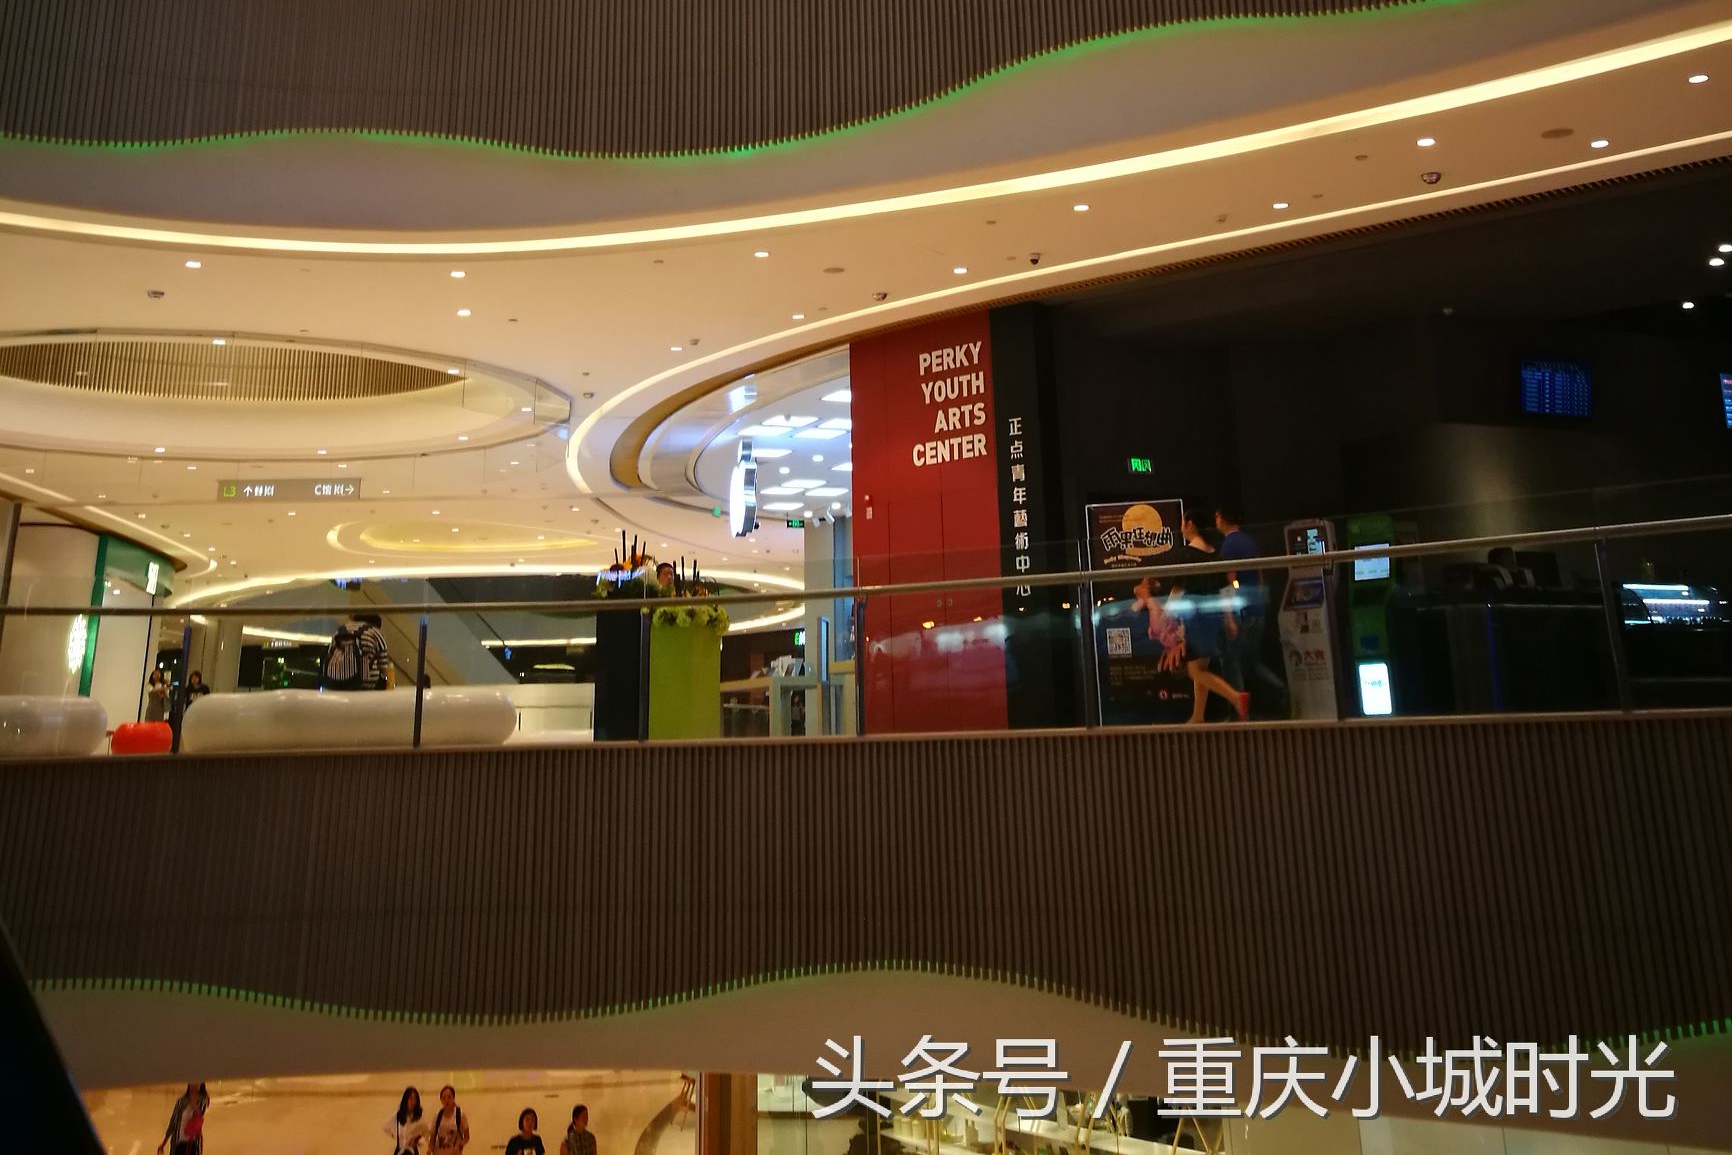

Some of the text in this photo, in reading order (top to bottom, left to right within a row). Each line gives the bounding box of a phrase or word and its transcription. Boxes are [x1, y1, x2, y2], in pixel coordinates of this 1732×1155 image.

[919, 341, 982, 376] PERKY
[921, 371, 985, 404] YOUTH
[934, 402, 986, 434] ARTS
[912, 433, 988, 467] CENTER
